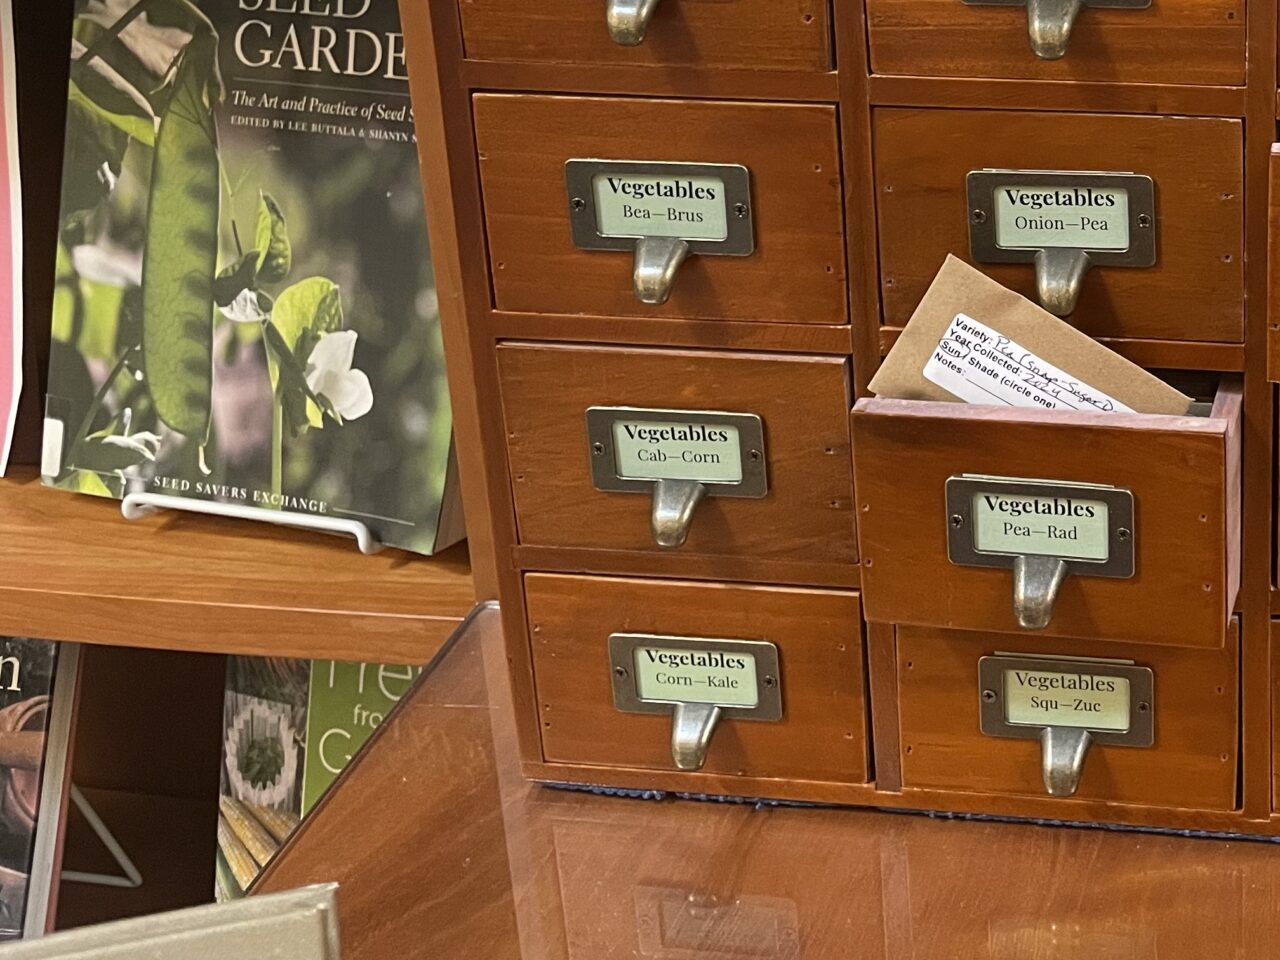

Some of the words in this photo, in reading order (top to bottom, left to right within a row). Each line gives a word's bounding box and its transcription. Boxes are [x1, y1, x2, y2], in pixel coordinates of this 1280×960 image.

[234, 19, 410, 81] GARDE
[231, 90, 256, 107] The
[258, 93, 279, 109] Art
[281, 95, 307, 112] and
[309, 97, 358, 117] Practice
[360, 102, 376, 122] of
[376, 103, 407, 122] Seed
[230, 114, 270, 128] EDITED
[273, 120, 284, 130] BY
[288, 120, 308, 132] LEE
[311, 123, 356, 138] BUTTALA
[358, 129, 366, 138] &
[368, 129, 408, 142] SHANYN
[606, 177, 715, 201] Vegetables
[1004, 189, 1115, 211] Vegetables
[955, 317, 993, 346] Variety:
[934, 352, 966, 376] Notes:
[949, 328, 972, 349] Year
[973, 343, 1023, 376] Collected:
[941, 340, 961, 358] Sun
[968, 356, 999, 380] Shade
[1000, 375, 1032, 398] (circle
[623, 423, 728, 443] Vegetables
[153, 475, 190, 491] SEED
[196, 482, 247, 500] SAVERS
[253, 490, 328, 514] EXCHANGE
[984, 495, 1096, 519] Vegetables
[645, 649, 746, 670] Vegetables
[1014, 671, 1115, 693] Vegetables
